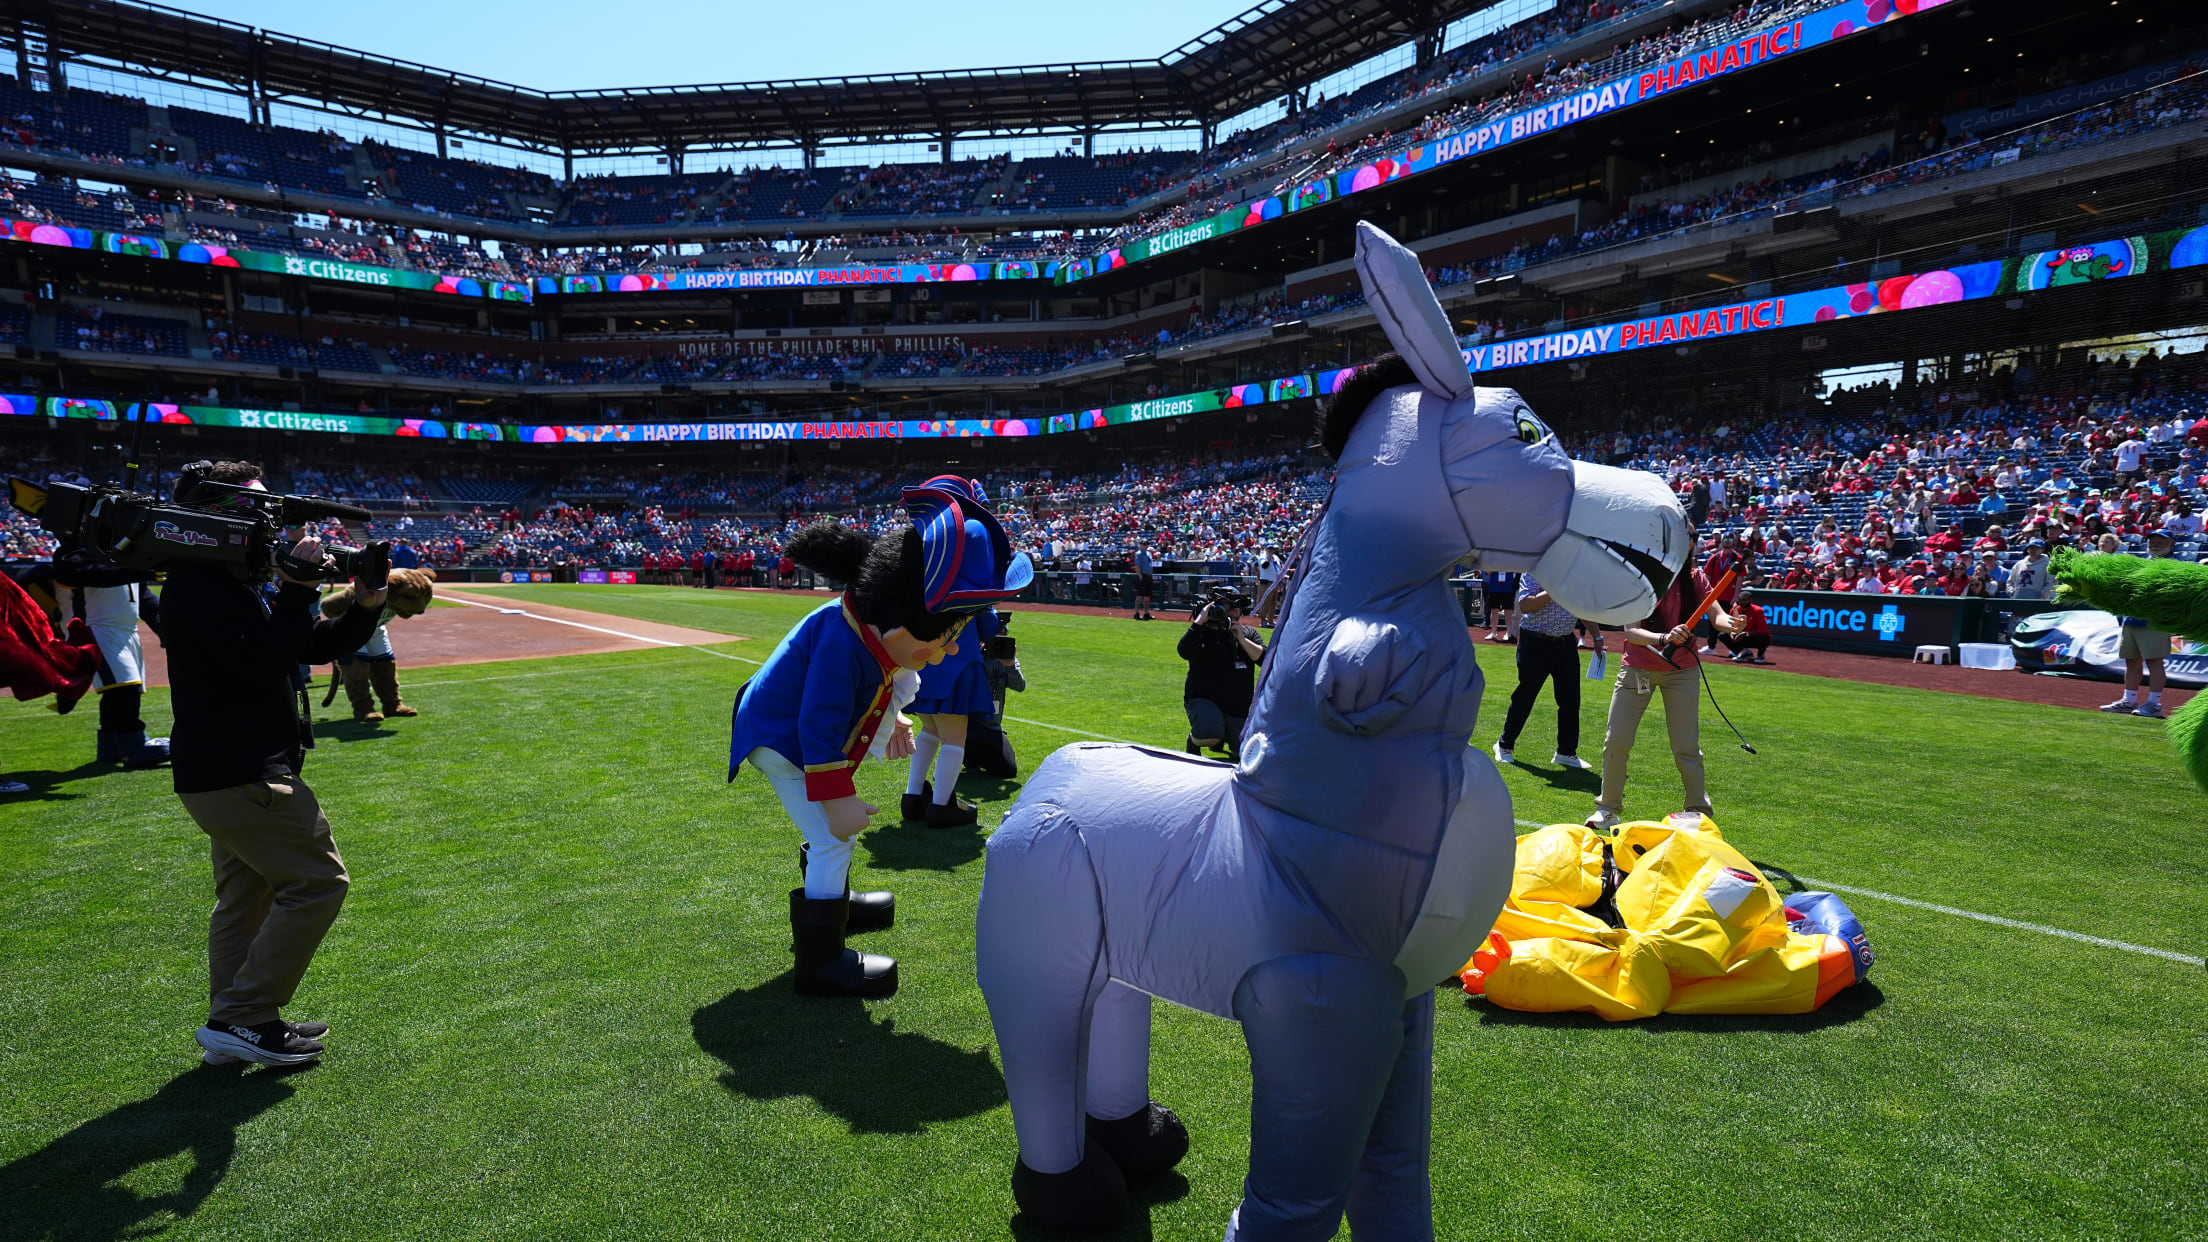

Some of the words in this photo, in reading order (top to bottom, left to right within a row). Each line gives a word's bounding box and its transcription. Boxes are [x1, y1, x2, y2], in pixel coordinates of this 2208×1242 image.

[1434, 121, 1506, 164] HAPPY
[1510, 79, 1633, 140] BIRTHDAY
[1638, 21, 1803, 99] PHANATIC!
[1959, 93, 2072, 130] CADILLAC
[2077, 77, 2138, 100] HALL
[2145, 66, 2178, 84] OF
[1161, 223, 1213, 252] Citizens
[309, 261, 390, 285] Citizens
[686, 273, 736, 288] HAPPY
[739, 270, 814, 287] BIRTHDAY
[818, 268, 902, 283] PHANATIC!
[1491, 326, 1615, 368] BIRTHDAY
[1619, 298, 1786, 348] PHANATIC!
[679, 343, 717, 356] HOME
[725, 342, 740, 356] OF
[749, 341, 774, 355] THE
[1143, 398, 1194, 419] Citizens
[263, 412, 349, 432] Citizens
[643, 424, 702, 441] HAPPY
[706, 423, 797, 441] BIRTHDAY
[802, 421, 903, 439] PHANATIC!
